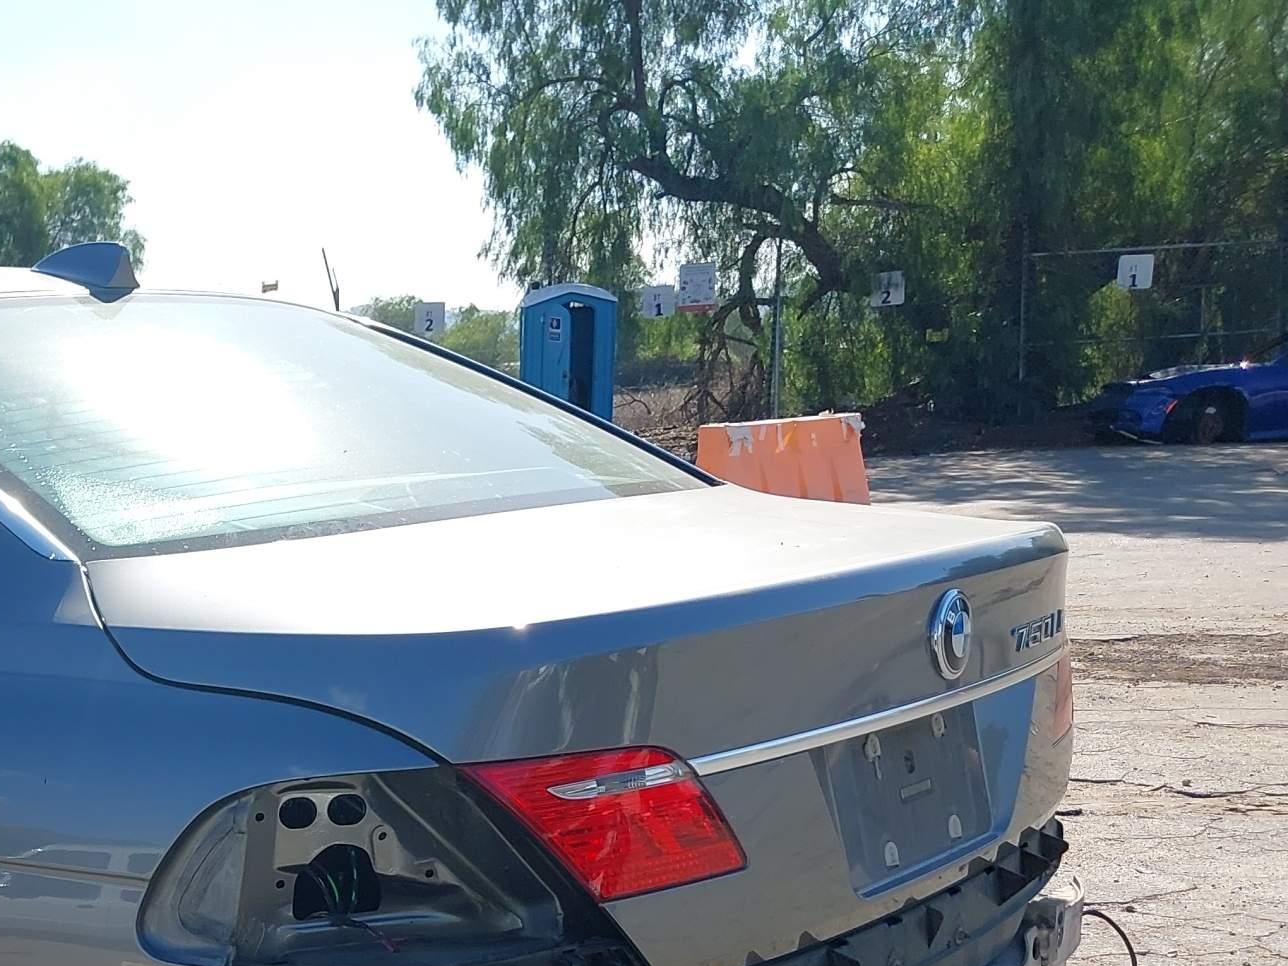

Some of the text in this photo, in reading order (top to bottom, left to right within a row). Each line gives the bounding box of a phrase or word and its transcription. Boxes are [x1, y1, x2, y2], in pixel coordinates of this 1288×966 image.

[1129, 273, 1138, 288] 1
[881, 290, 891, 305] 2
[655, 303, 664, 317] 1
[425, 318, 434, 332] 2
